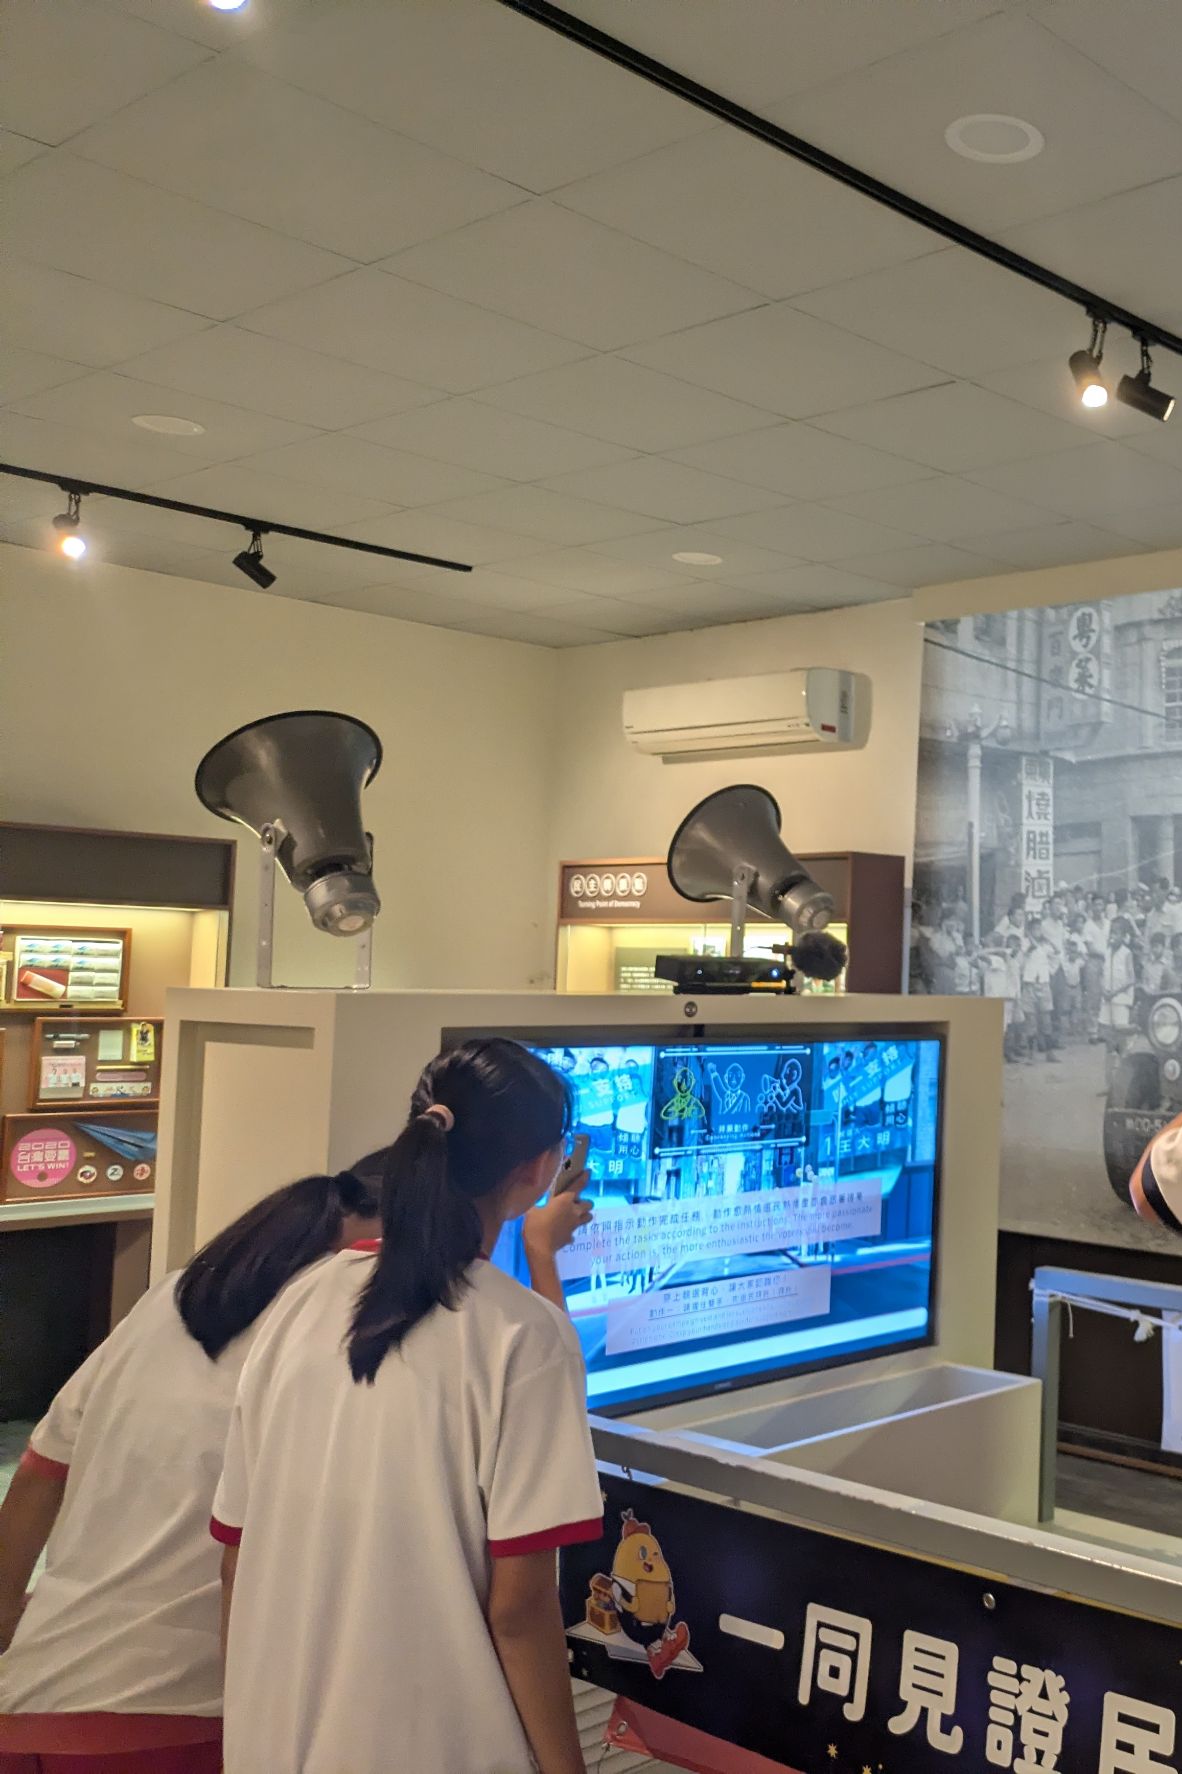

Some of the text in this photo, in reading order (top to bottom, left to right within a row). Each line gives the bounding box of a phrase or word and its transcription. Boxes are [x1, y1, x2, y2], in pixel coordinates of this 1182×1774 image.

[18, 1140, 70, 1151] 2020
[17, 1161, 70, 1172] LET'S WIN!
